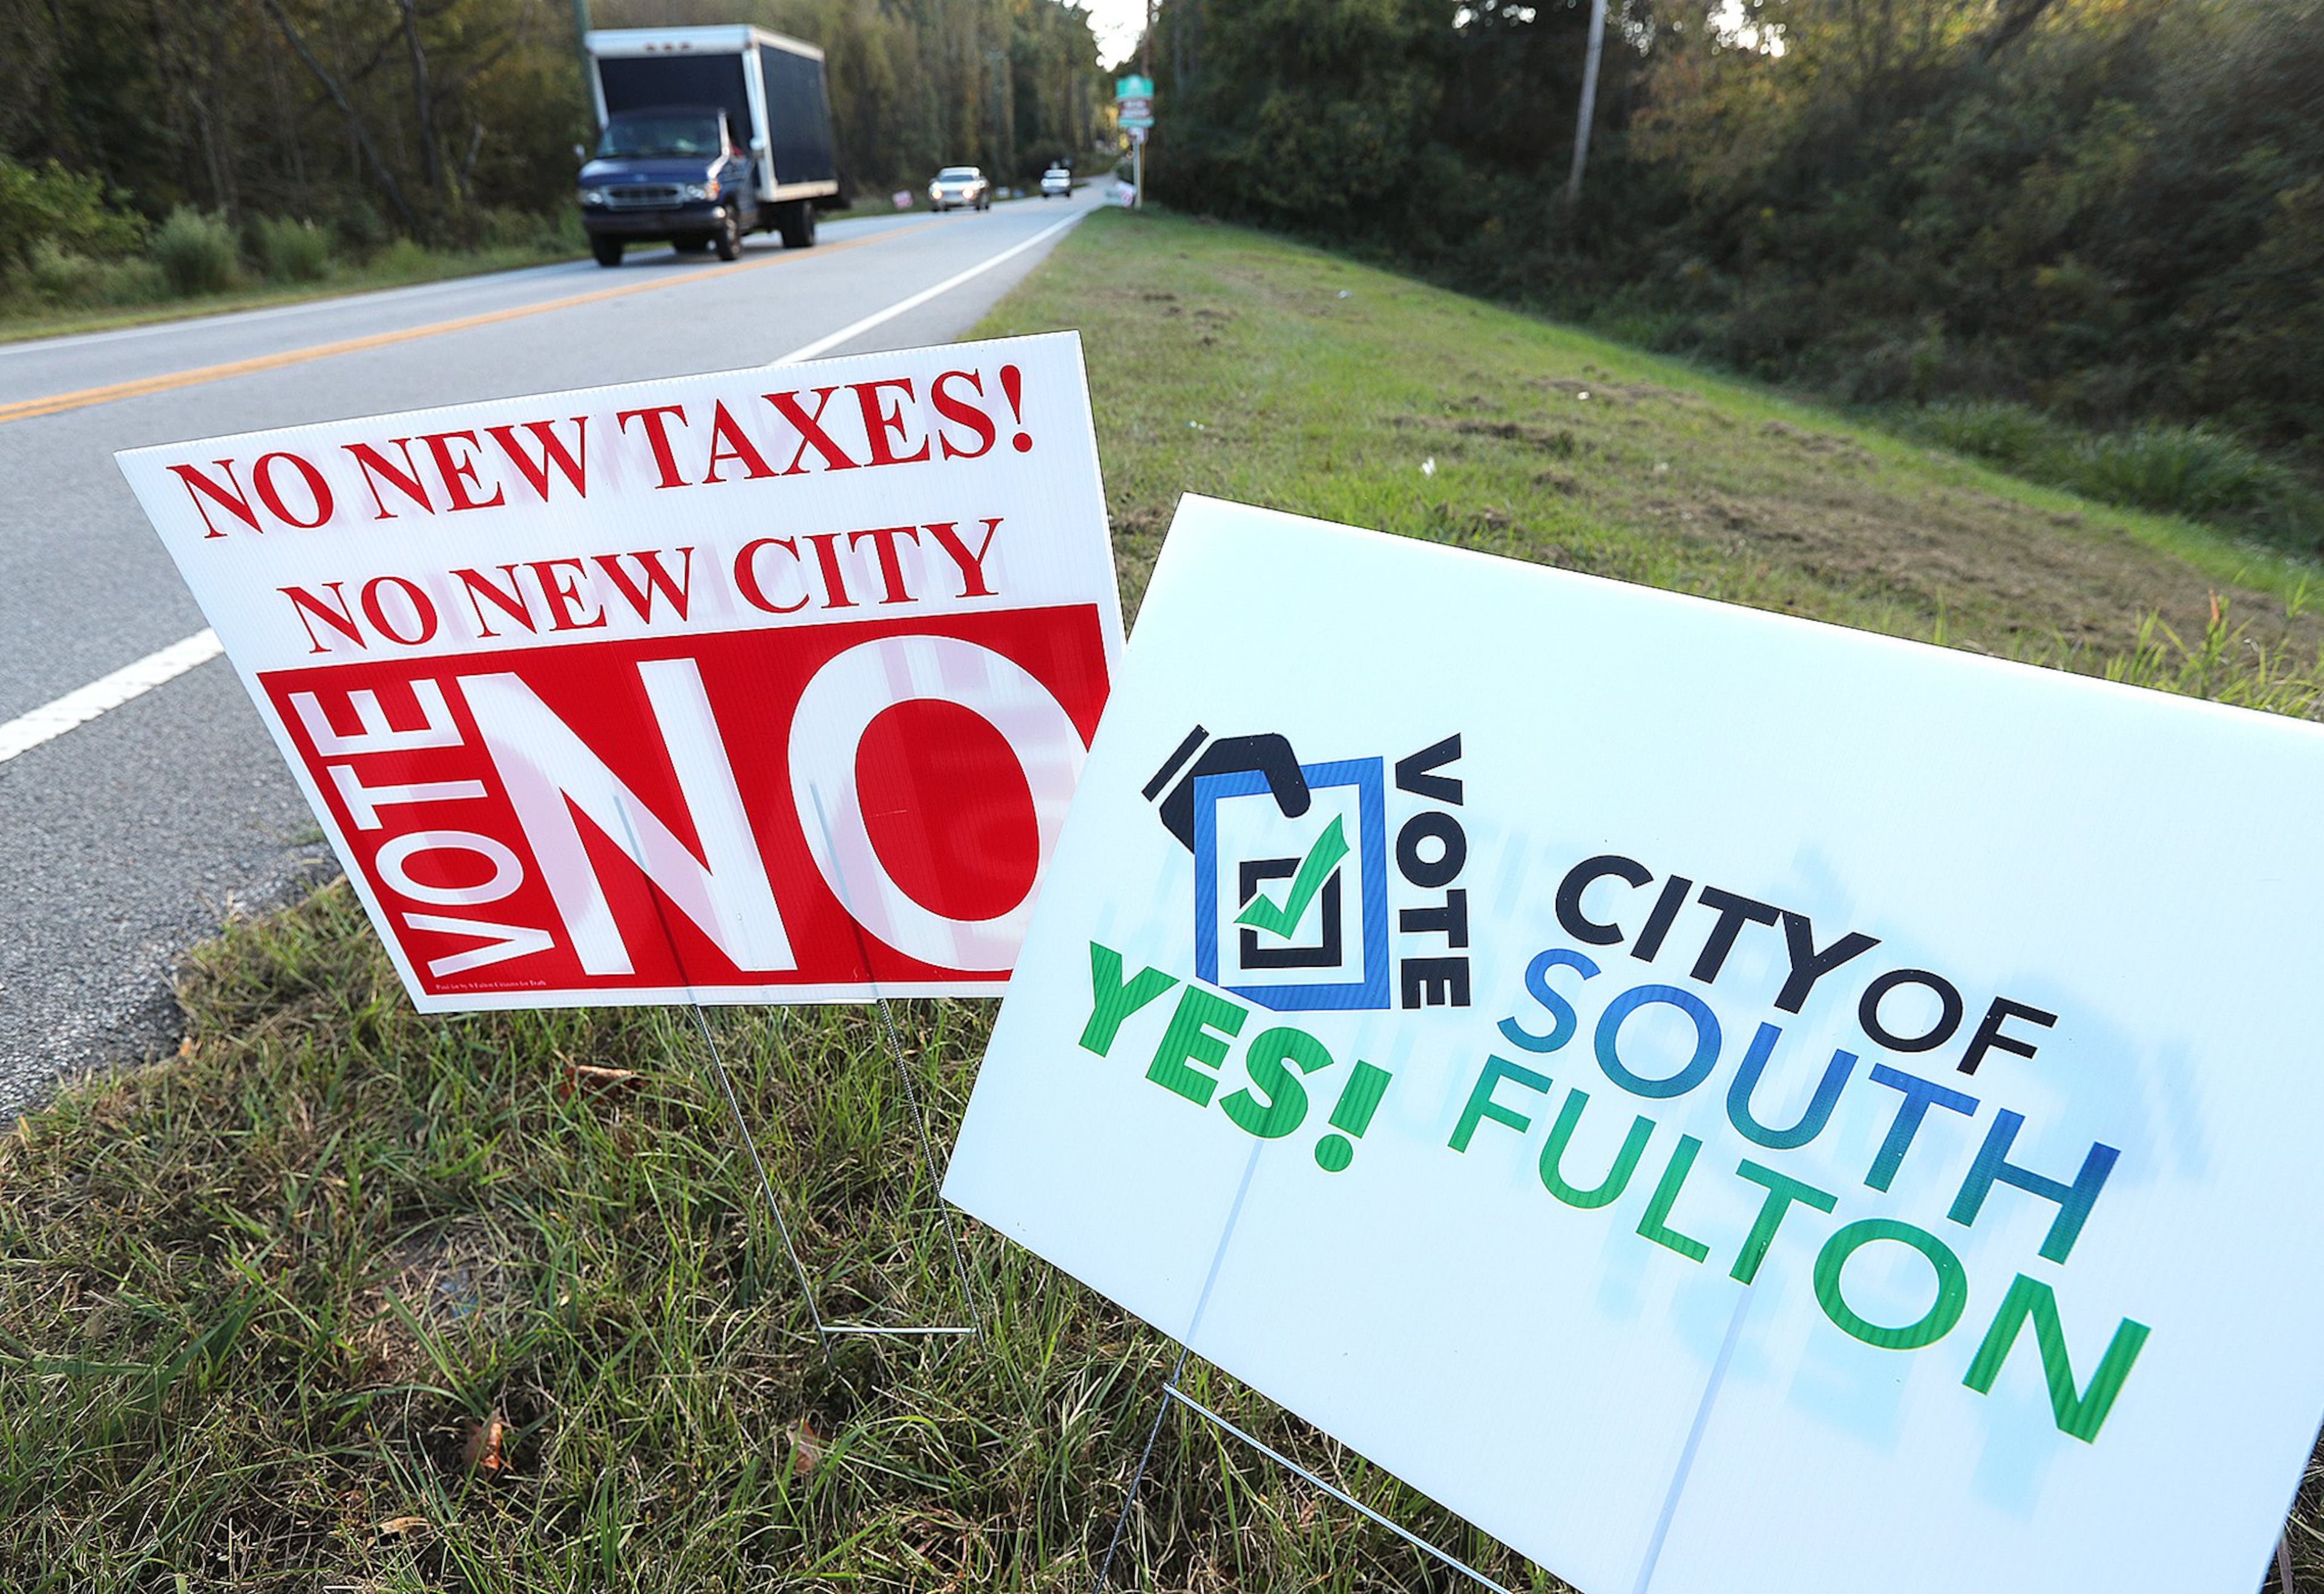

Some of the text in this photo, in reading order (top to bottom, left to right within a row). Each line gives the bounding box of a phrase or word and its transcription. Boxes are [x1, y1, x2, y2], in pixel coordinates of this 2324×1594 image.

[166, 364, 1033, 538] NO NEW TAXES!
[277, 517, 1003, 654] NO NEW CITY
[287, 679, 555, 977] VOTE
[456, 634, 1088, 976] NO
[1395, 733, 1471, 1009] VOTE
[1078, 940, 1393, 1172] YES!
[1555, 855, 2058, 1075] CITY OF
[1497, 947, 2121, 1265] SOUTH
[1447, 1055, 2152, 1444] FULTON
